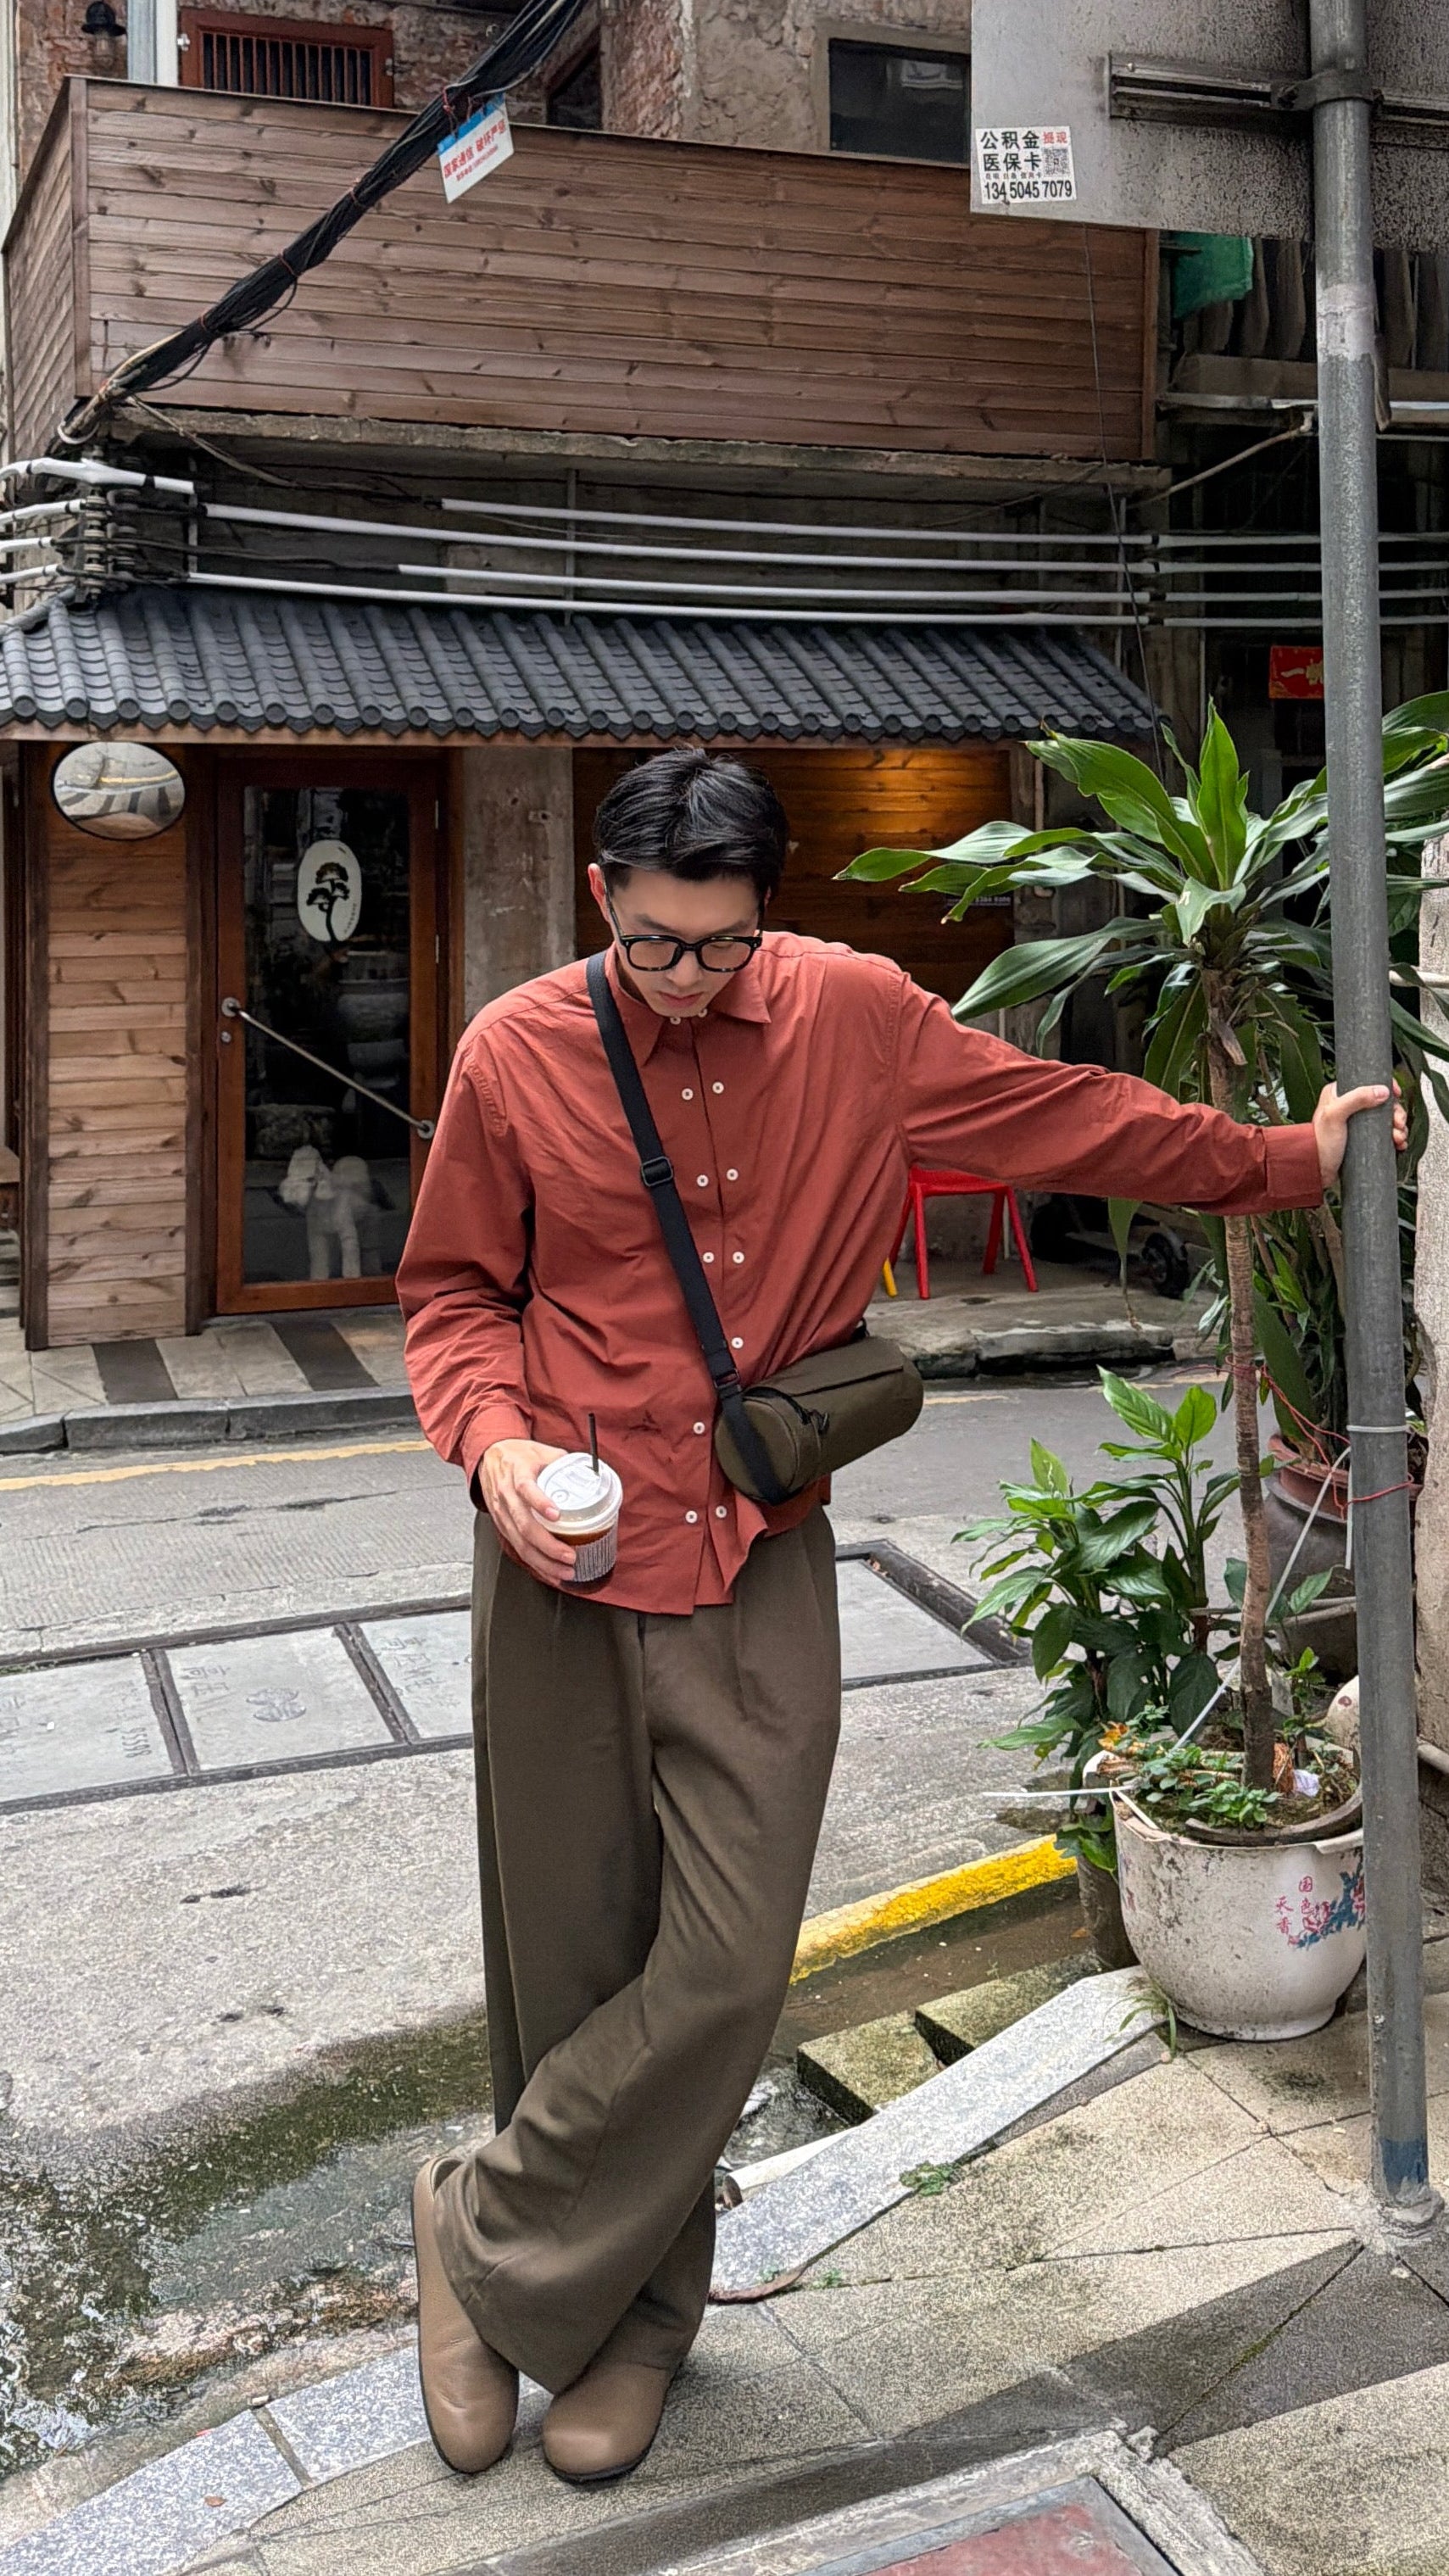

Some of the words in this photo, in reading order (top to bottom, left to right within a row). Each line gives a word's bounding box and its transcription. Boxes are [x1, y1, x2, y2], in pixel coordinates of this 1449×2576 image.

[980, 131, 1040, 150] 公积金
[983, 152, 1041, 171] 医保卡
[1299, 1876, 1314, 1915] 国色
[1275, 1896, 1294, 1937] 天香
